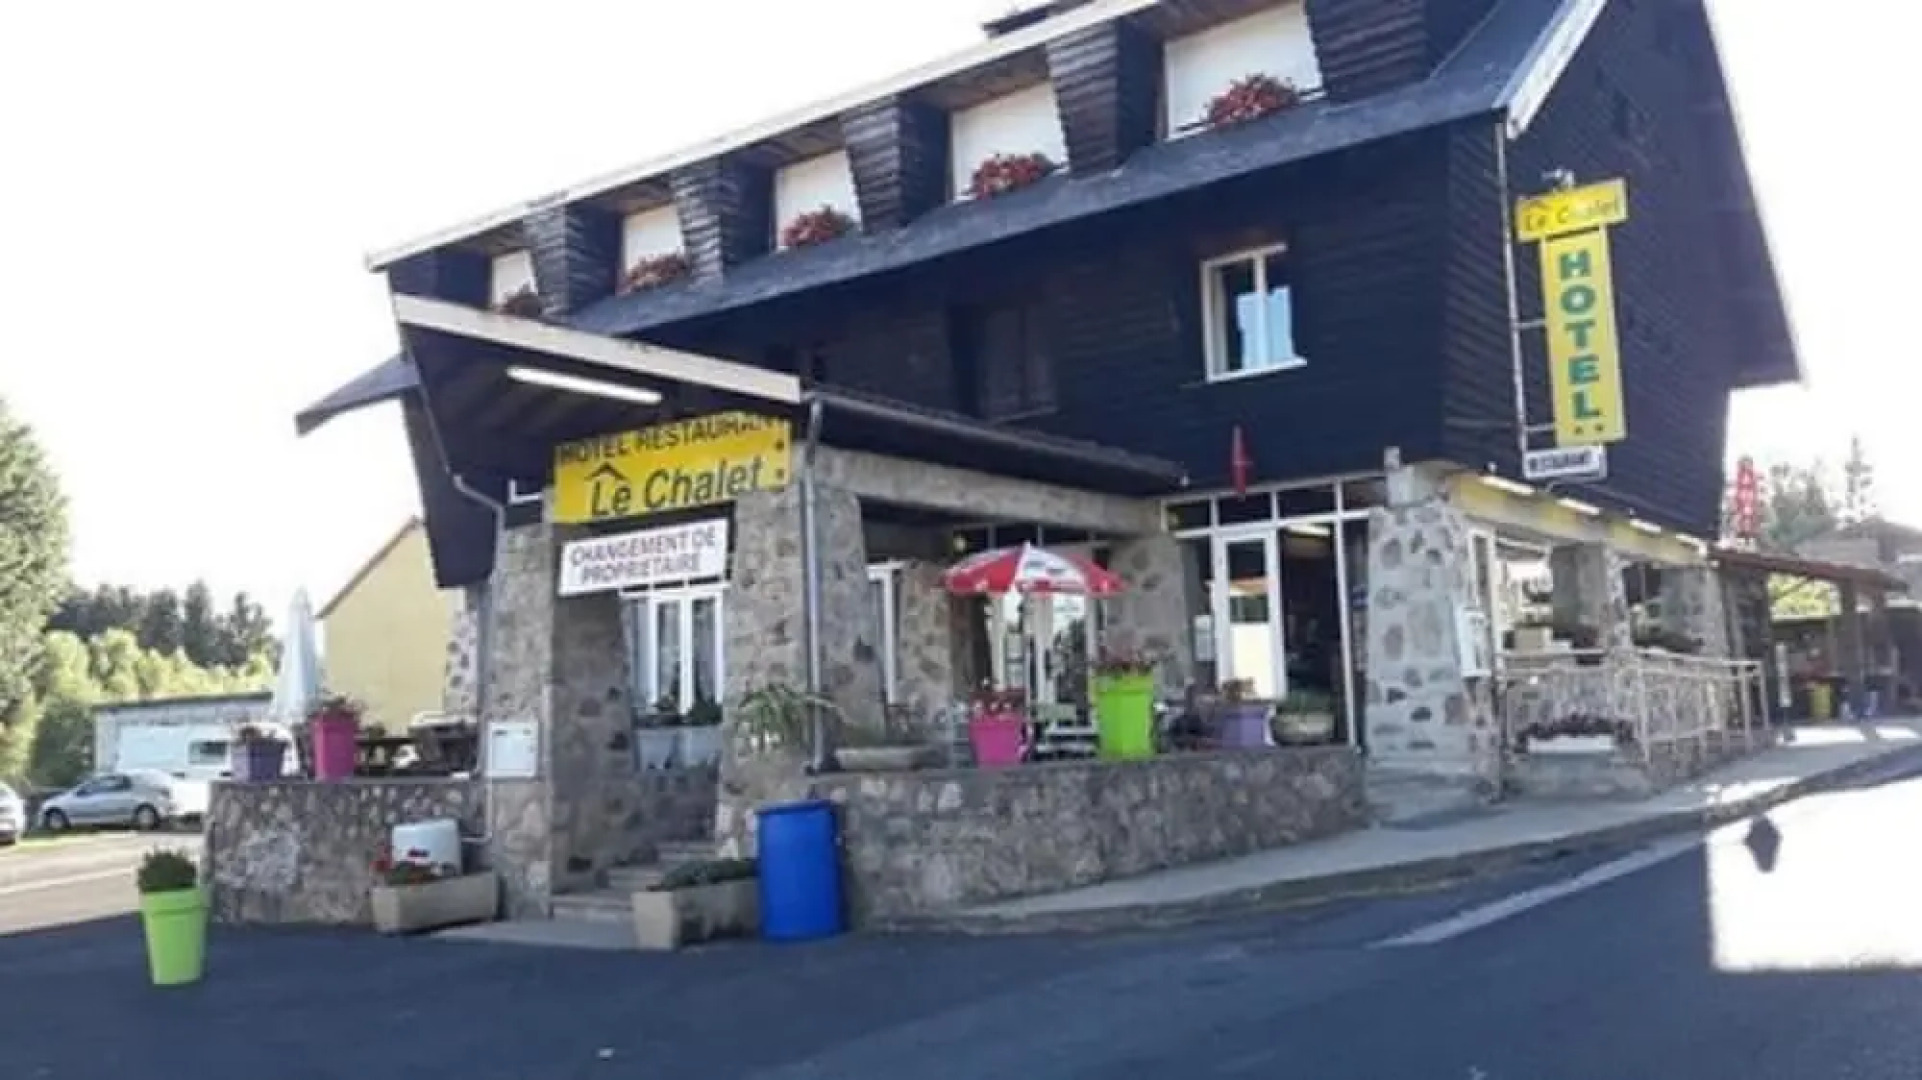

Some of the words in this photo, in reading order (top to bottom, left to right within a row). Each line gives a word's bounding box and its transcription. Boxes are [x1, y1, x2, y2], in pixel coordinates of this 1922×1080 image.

[1558, 250, 1604, 421] HOTEL
[634, 414, 775, 455] RESTAURA
[591, 476, 632, 517] Le
[644, 457, 763, 509] Chalet
[570, 530, 689, 568] CHANGEMENT
[692, 524, 716, 548] DE
